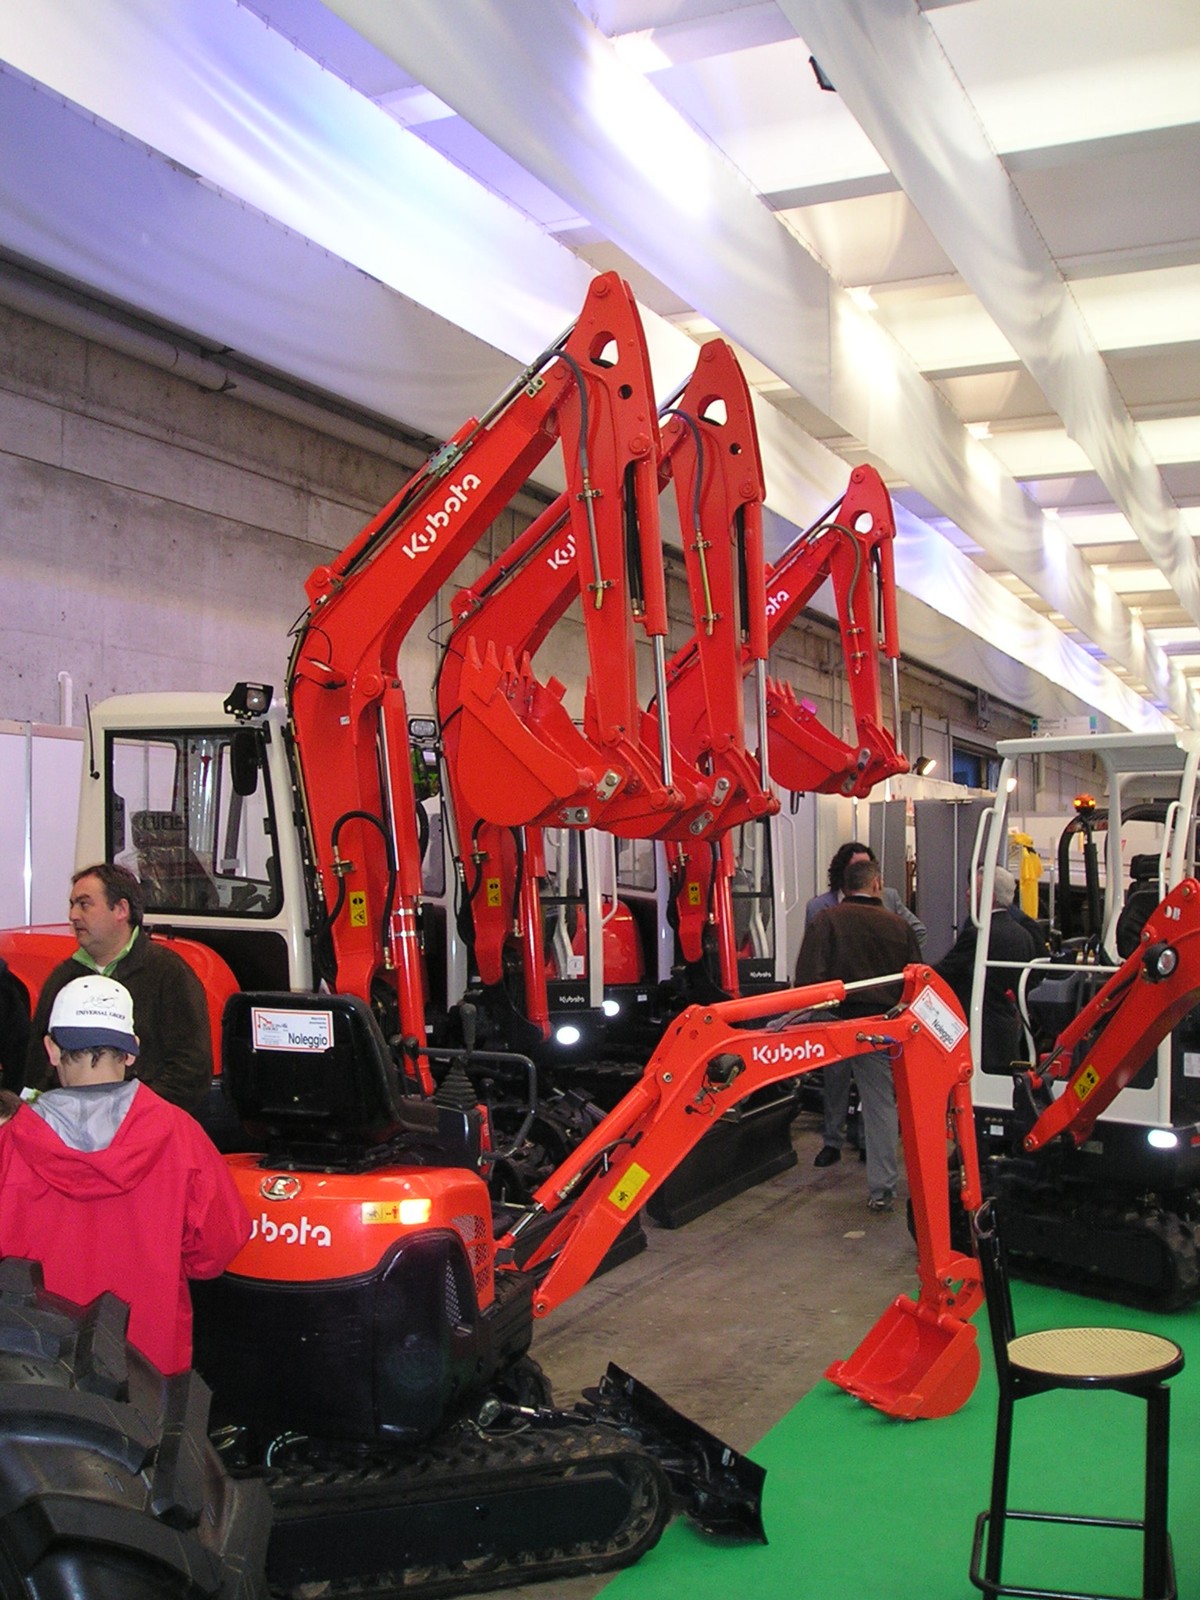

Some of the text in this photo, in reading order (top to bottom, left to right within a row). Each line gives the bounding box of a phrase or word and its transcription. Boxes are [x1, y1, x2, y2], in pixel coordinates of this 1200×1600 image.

[402, 474, 481, 559] Kubota
[75, 1009, 108, 1017] UNIVERSAL
[288, 1032, 328, 1048] Noleggio
[752, 1039, 825, 1065] Kubota
